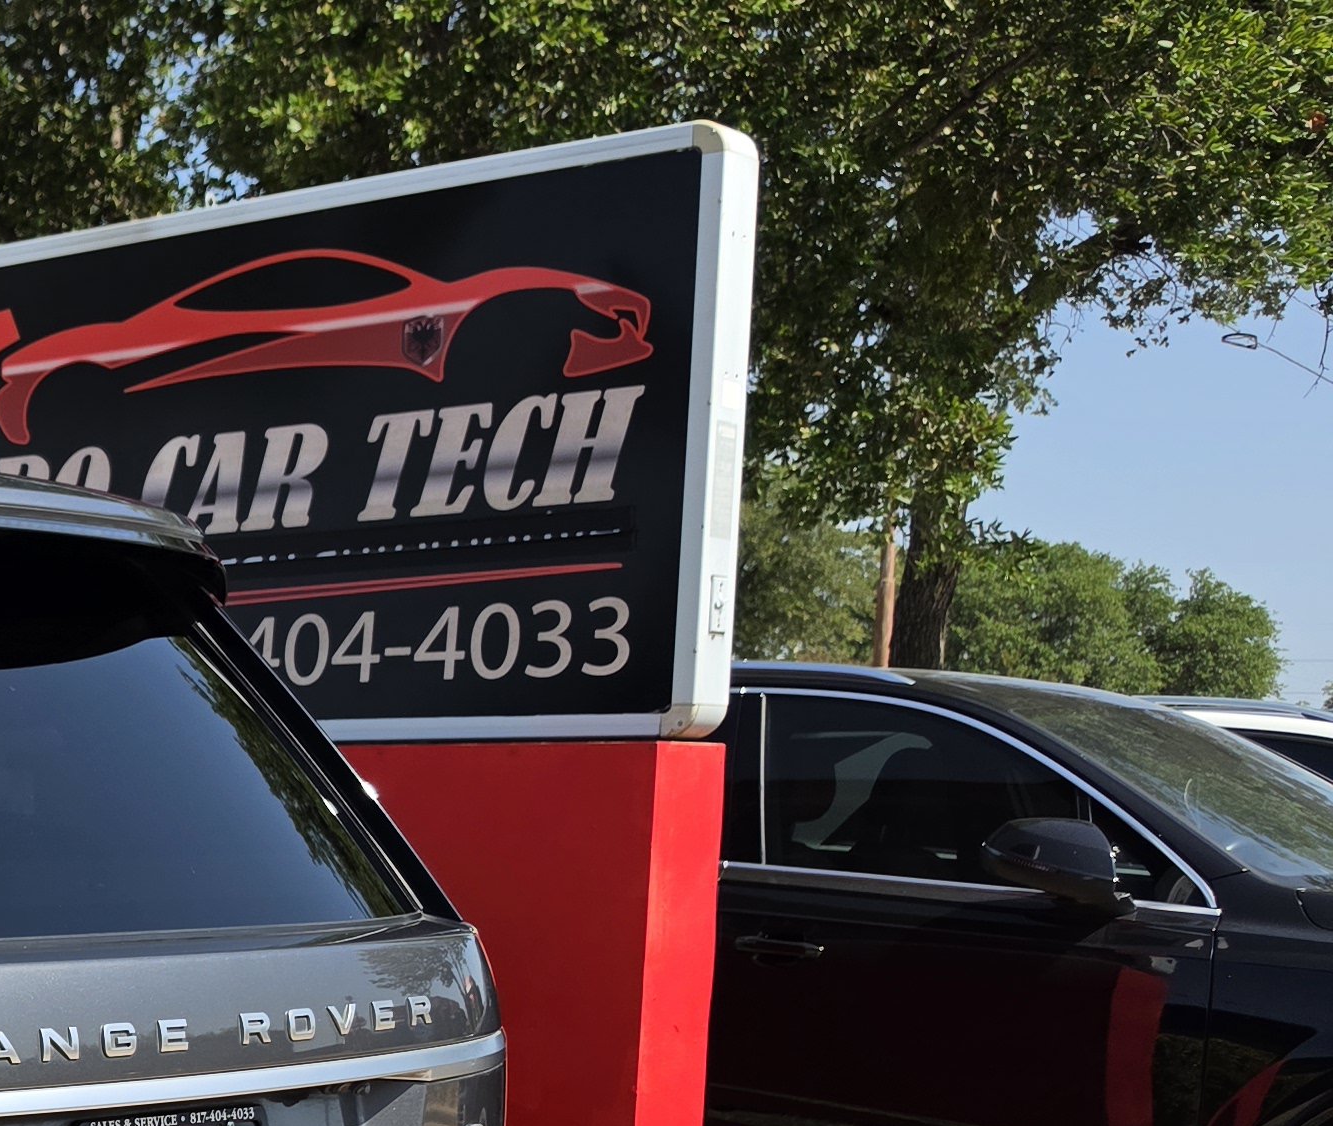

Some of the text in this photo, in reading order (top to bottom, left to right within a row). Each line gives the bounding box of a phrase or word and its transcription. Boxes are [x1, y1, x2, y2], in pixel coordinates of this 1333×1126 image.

[140, 422, 329, 535] CAR
[356, 384, 646, 522] TECH
[239, 995, 432, 1045] ROVER
[189, 1107, 254, 1124] 817-404-4033
